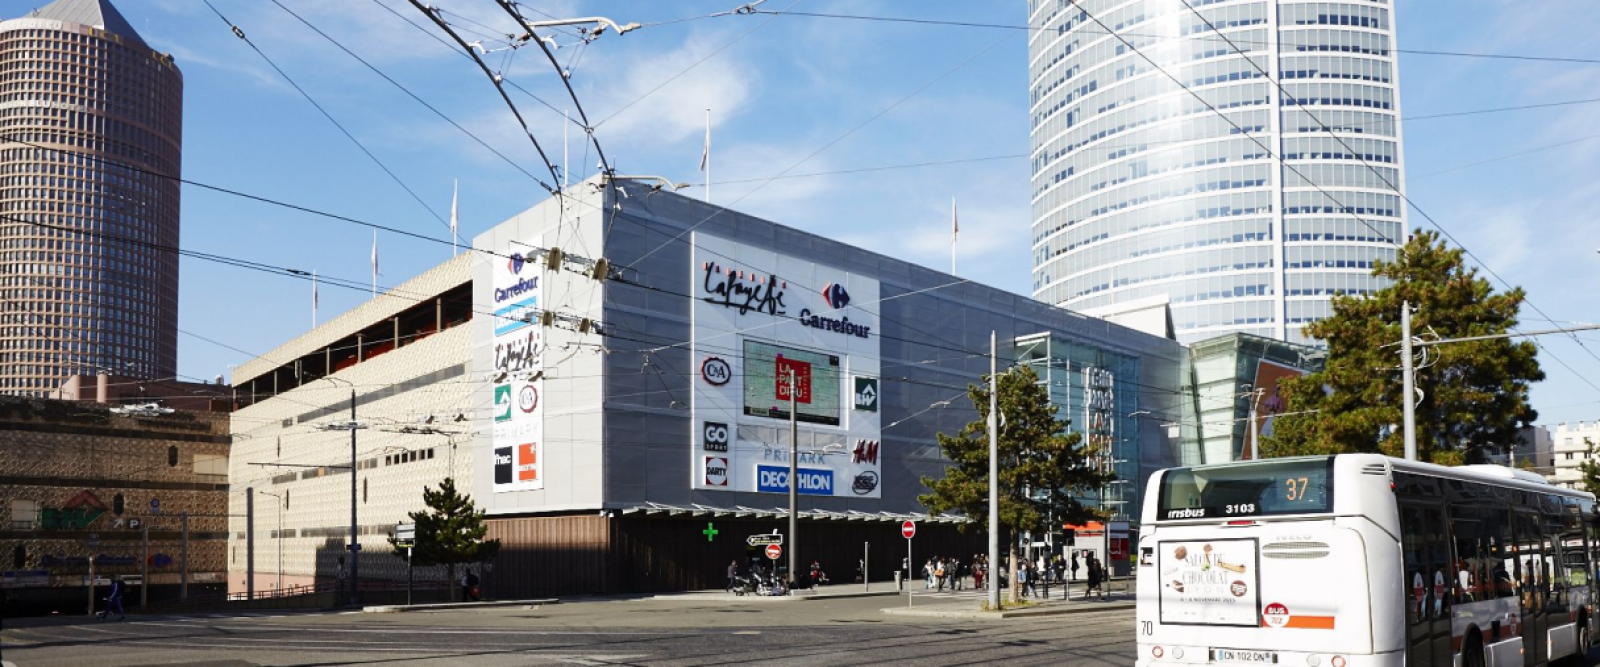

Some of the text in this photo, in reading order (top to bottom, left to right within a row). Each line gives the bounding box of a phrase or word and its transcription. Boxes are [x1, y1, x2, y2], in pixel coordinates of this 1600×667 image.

[494, 276, 539, 303] Carrefour
[800, 308, 871, 339] Carrefour
[706, 363, 726, 379] C&A
[778, 362, 791, 373] LA
[778, 374, 803, 386] PAT
[778, 386, 803, 398] DIU
[705, 426, 728, 443] GO
[764, 447, 826, 465] PRIARK
[851, 438, 879, 466] H&M
[706, 466, 727, 476] DARTY
[760, 470, 831, 490] DECAHLON
[1285, 477, 1309, 501] 37
[1225, 503, 1255, 514] 3103
[1182, 570, 1230, 585] CHOCOLAT
[1187, 586, 1225, 594] LYON
[1141, 620, 1153, 636] 70
[1237, 651, 1252, 661] 102
